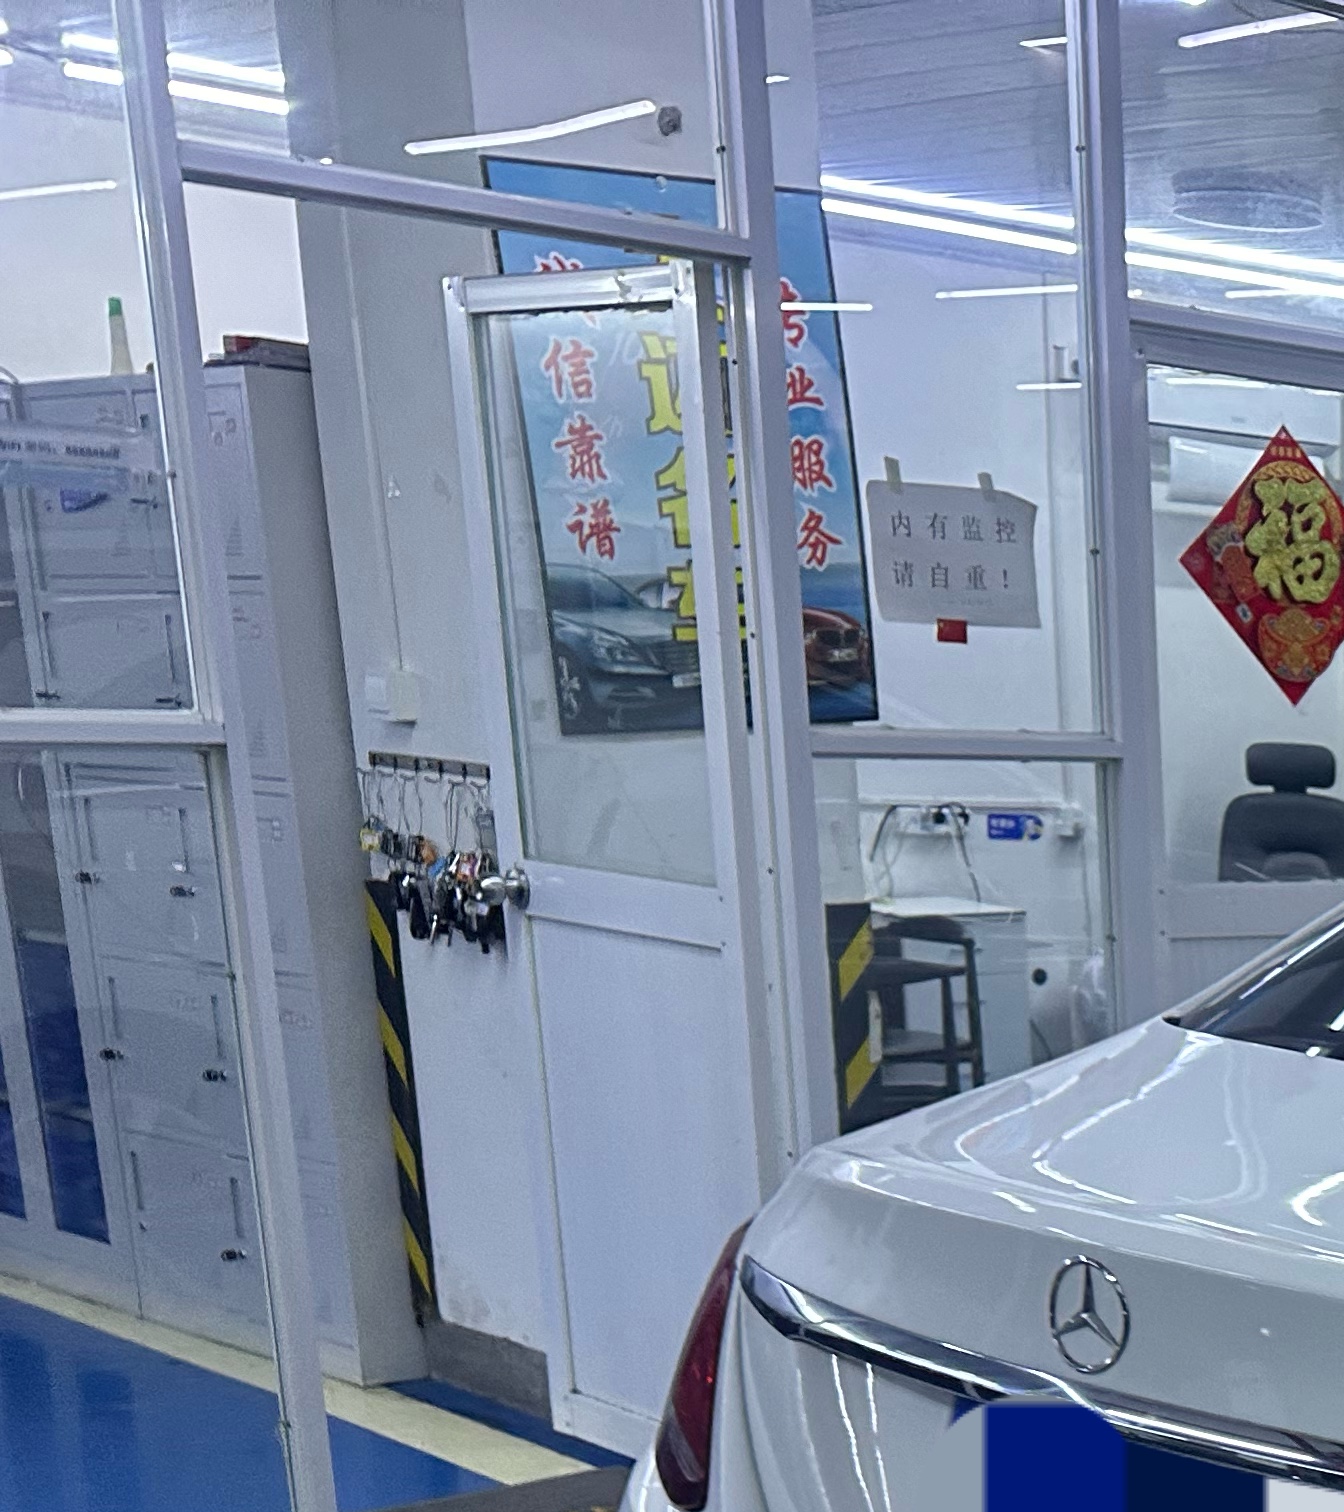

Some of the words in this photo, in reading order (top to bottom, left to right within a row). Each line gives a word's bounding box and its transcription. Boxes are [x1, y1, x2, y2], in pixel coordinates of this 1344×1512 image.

[890, 510, 1017, 544] 内有监控
[1244, 477, 1341, 604] 福
